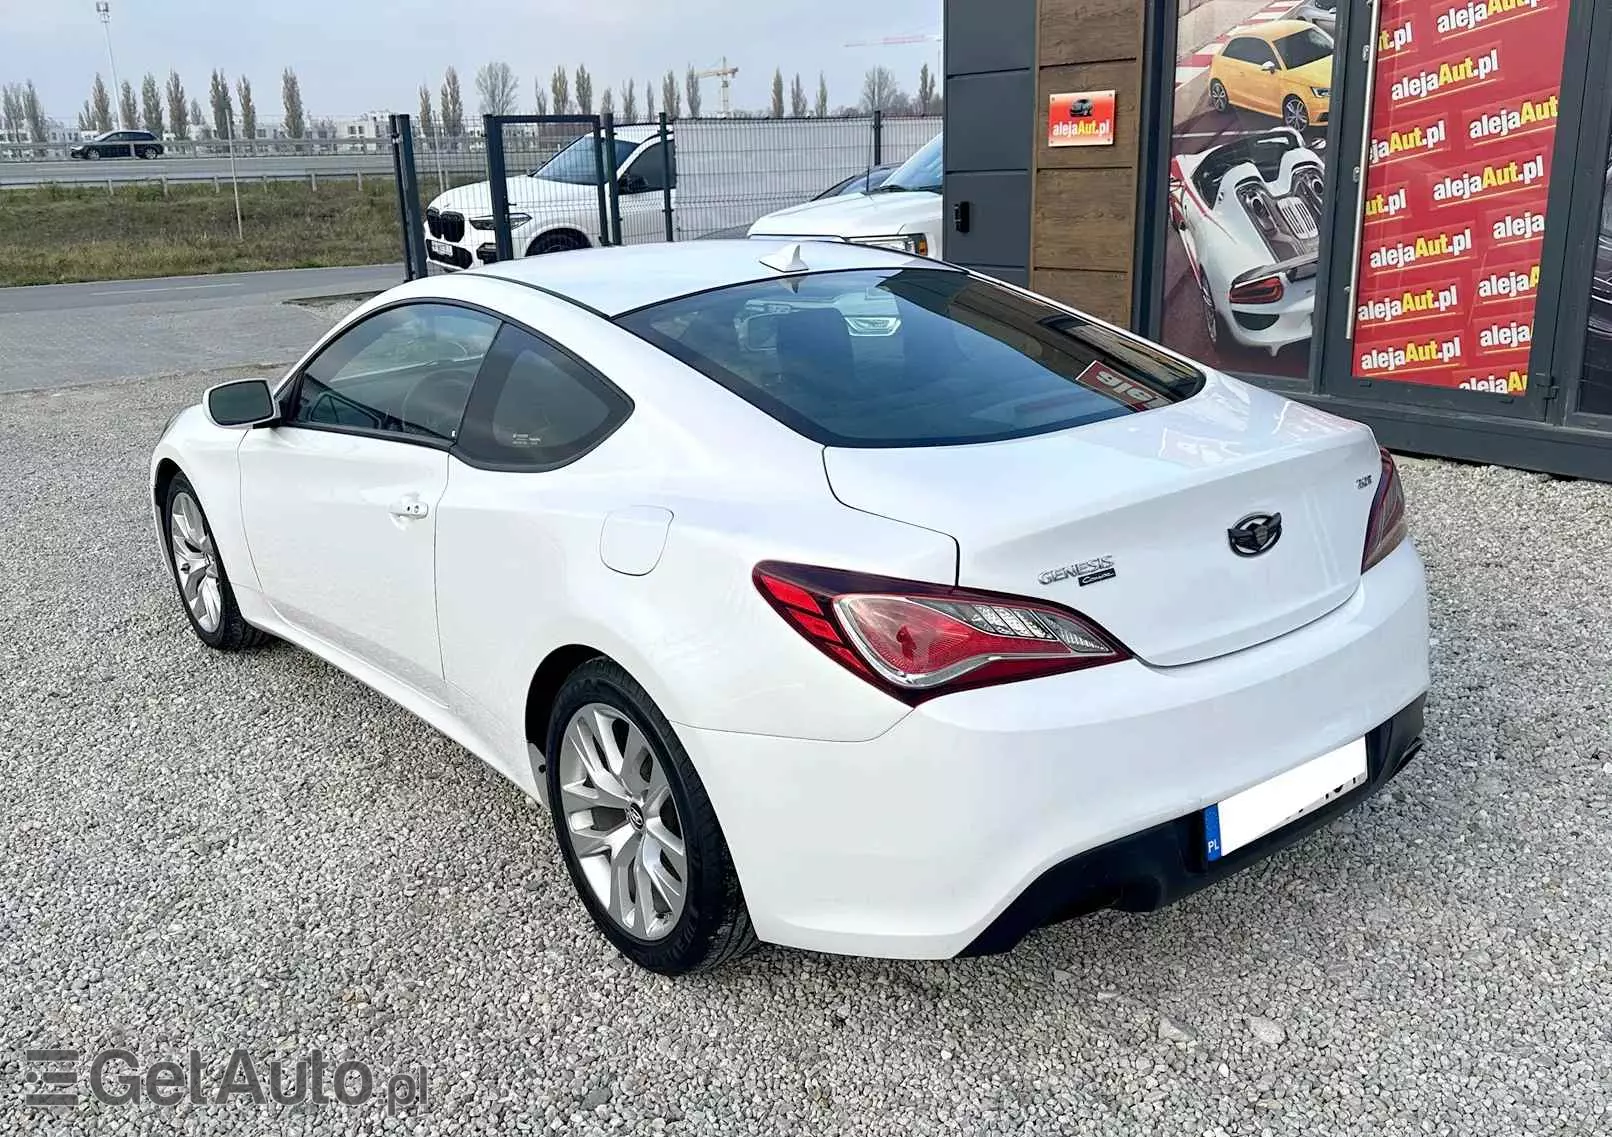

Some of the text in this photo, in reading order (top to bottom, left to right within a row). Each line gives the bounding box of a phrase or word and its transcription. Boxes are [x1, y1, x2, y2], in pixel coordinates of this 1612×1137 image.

[1391, 48, 1499, 101] alejaAut.pl
[1052, 119, 1110, 138] alejaAut.pl
[1469, 96, 1558, 140] alejaAut
[1433, 156, 1544, 201] alejaAut.pl
[1492, 211, 1545, 240] aleja
[1370, 228, 1472, 269] alejaAut.pl
[1358, 285, 1458, 322] alejaAut.pl
[1361, 336, 1461, 371] alejaAut.pl
[1039, 554, 1115, 585] GENESIS
[1208, 839, 1219, 853] PL
